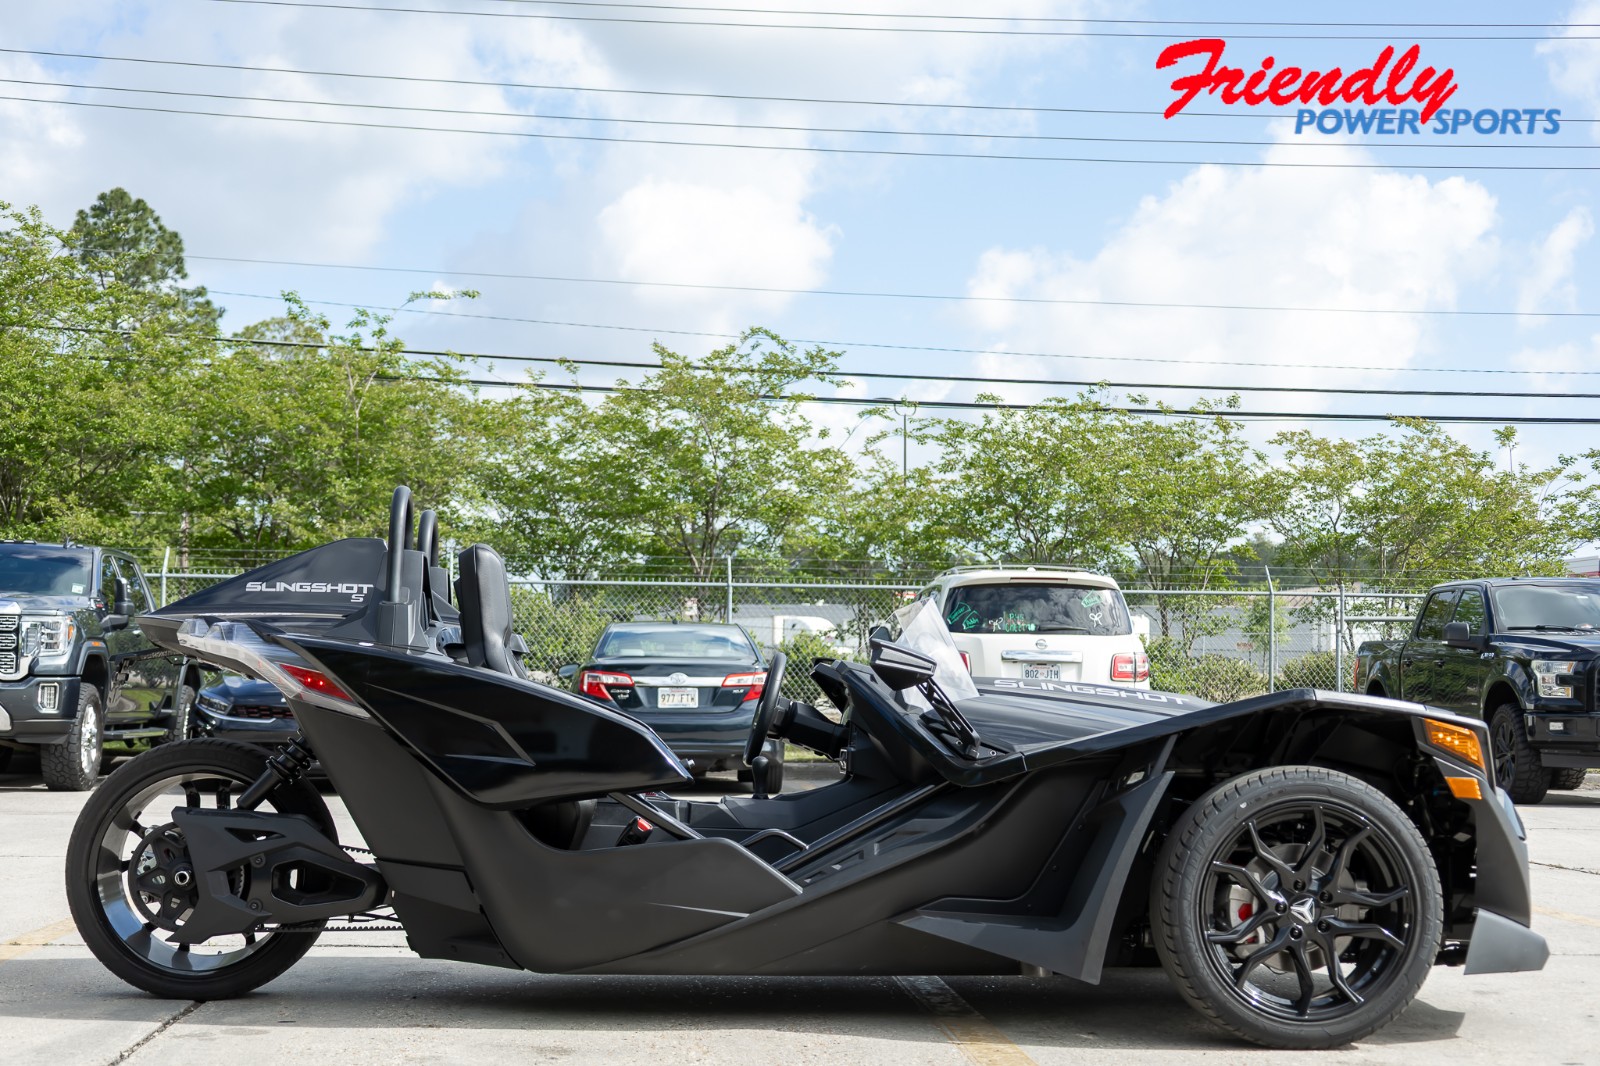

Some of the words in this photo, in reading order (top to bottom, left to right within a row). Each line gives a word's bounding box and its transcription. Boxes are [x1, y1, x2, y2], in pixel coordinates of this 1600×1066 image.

[245, 581, 374, 594] SLINGSHOT
[350, 594, 364, 603] S
[1025, 669, 1039, 679] 802
[993, 679, 1190, 705] SLINGSHOT
[660, 693, 676, 703] 977
